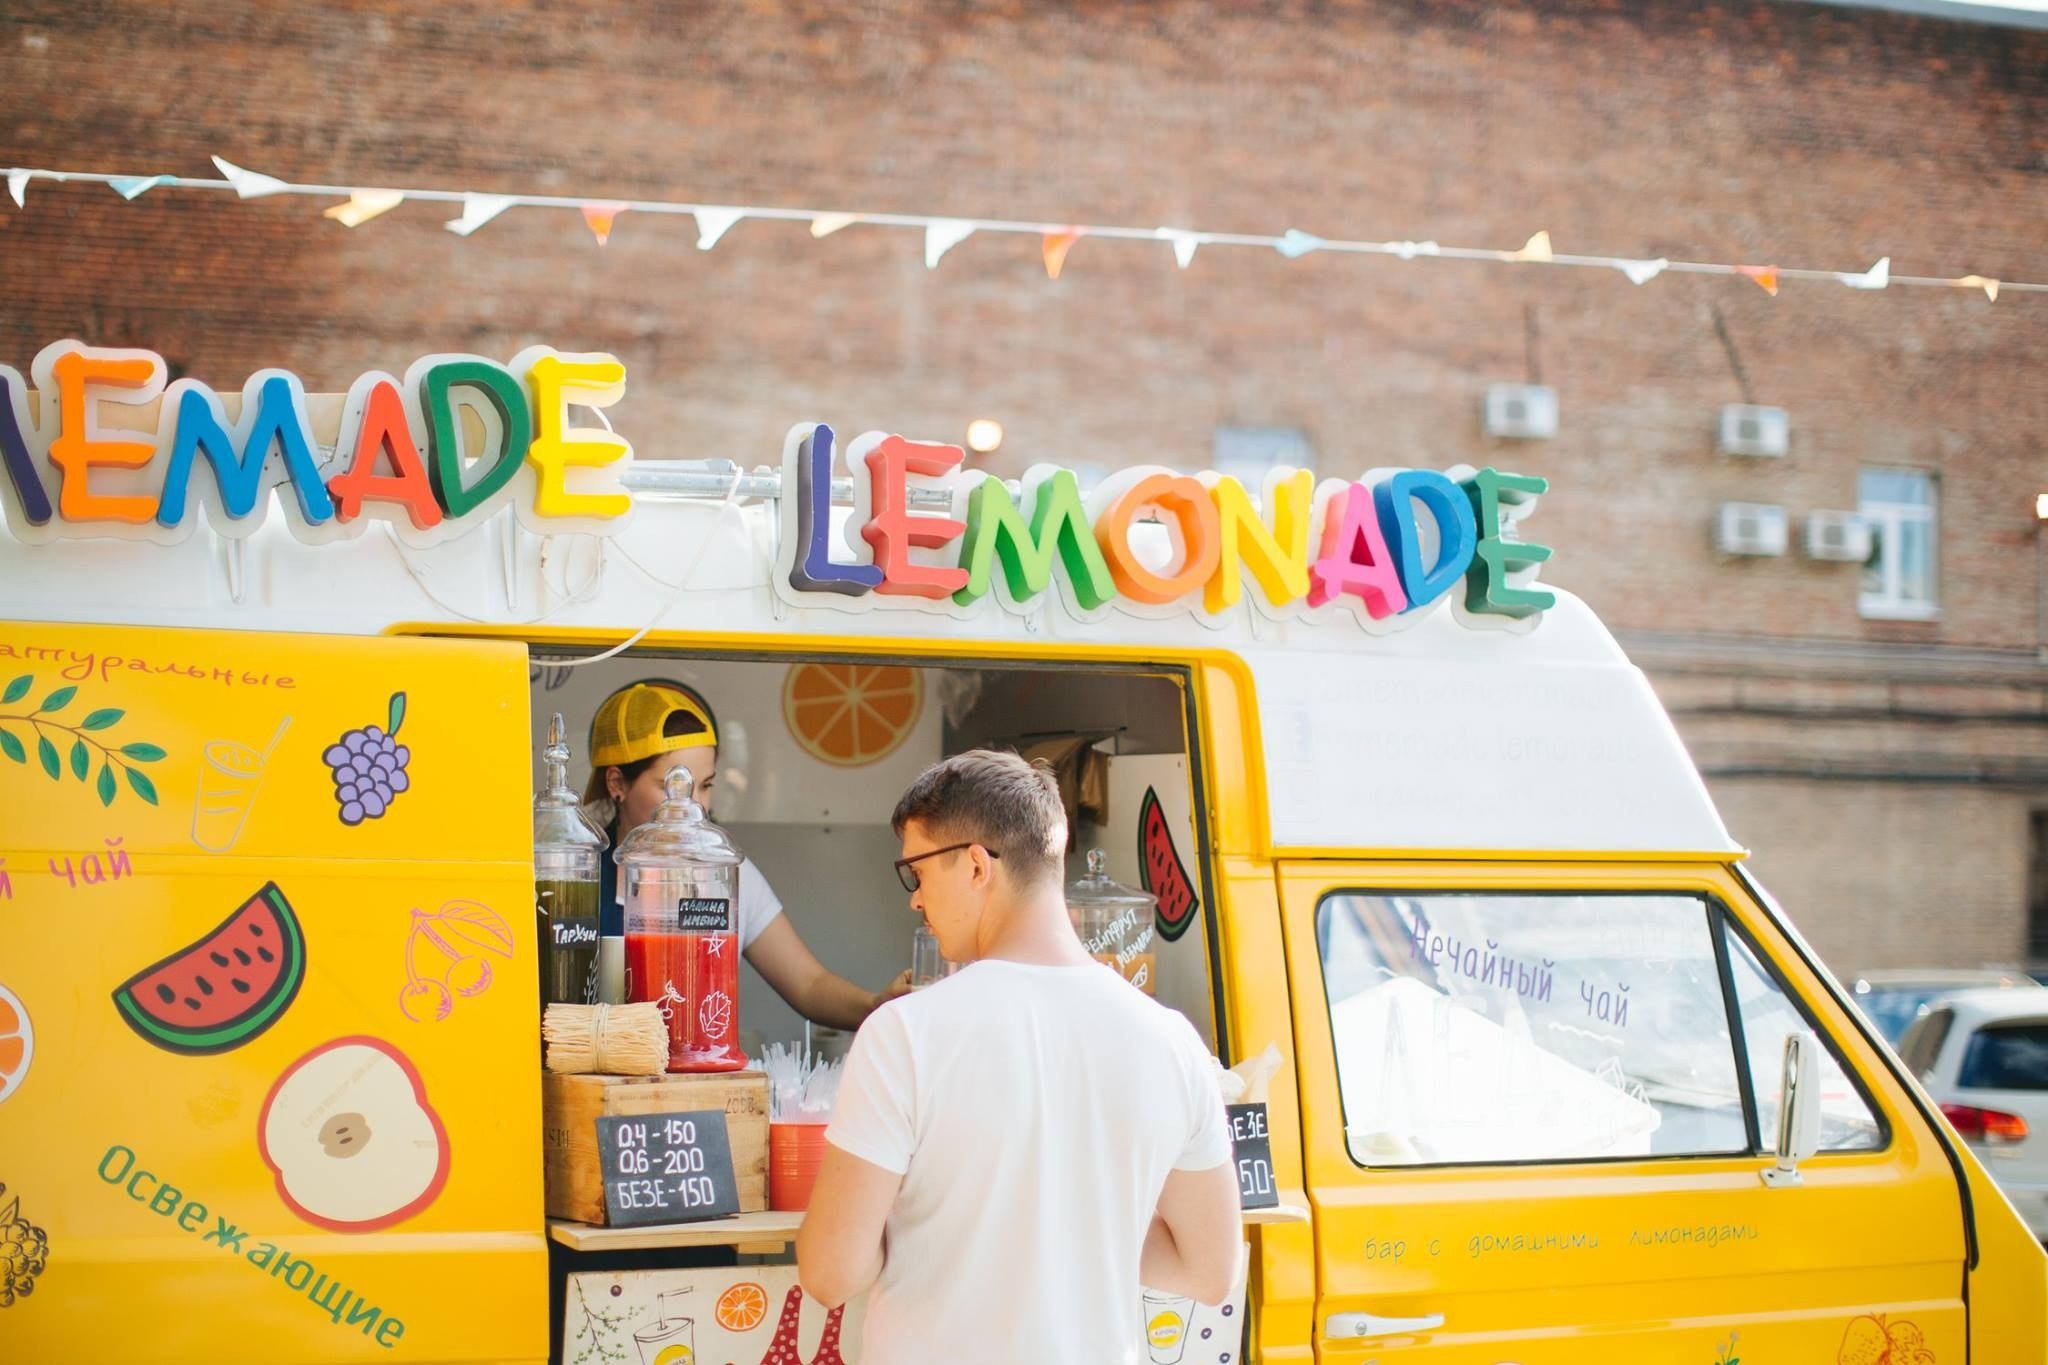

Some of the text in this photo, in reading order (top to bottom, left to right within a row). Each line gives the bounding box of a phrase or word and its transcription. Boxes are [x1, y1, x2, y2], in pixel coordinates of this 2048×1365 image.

[0, 351, 632, 530] EMADE
[787, 423, 1557, 621] LEMONADE
[47, 836, 132, 888] чай
[1409, 915, 1555, 1003] Нечайный
[1580, 980, 1631, 1028] чай
[97, 1145, 406, 1349] Освежающие
[1366, 1222, 1760, 1264] бар с домашними лимонадами
